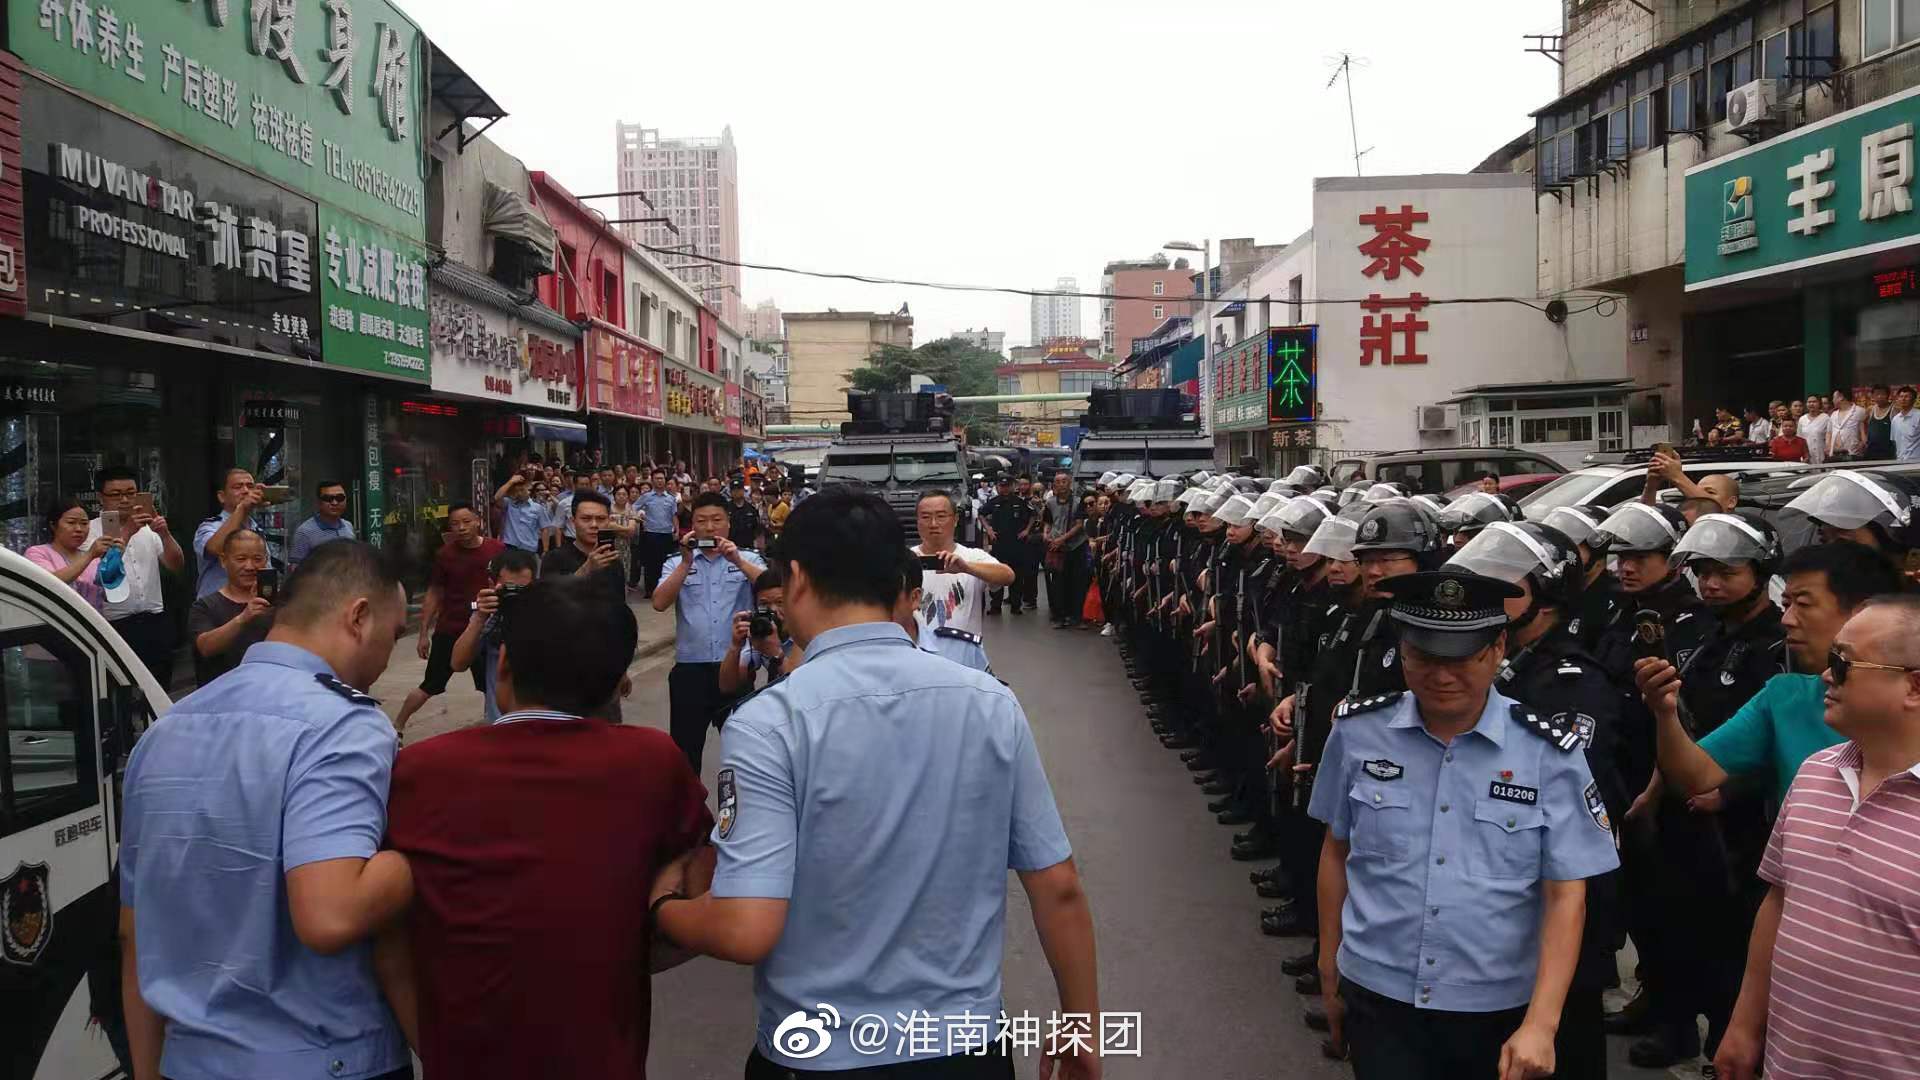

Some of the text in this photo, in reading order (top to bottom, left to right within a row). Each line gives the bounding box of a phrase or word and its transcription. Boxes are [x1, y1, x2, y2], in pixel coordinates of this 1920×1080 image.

[160, 43, 240, 129] 产后塑形
[209, 0, 408, 141] 瘦身馆
[1786, 122, 1914, 237] 丰原
[79, 205, 190, 260] PROFESSIONAL
[203, 200, 311, 293] 沐梵星
[324, 225, 425, 311] 专业减肥祛斑
[1273, 339, 1310, 409] 茶
[1272, 428, 1312, 448] 新茶
[1492, 784, 1536, 801] 018206
